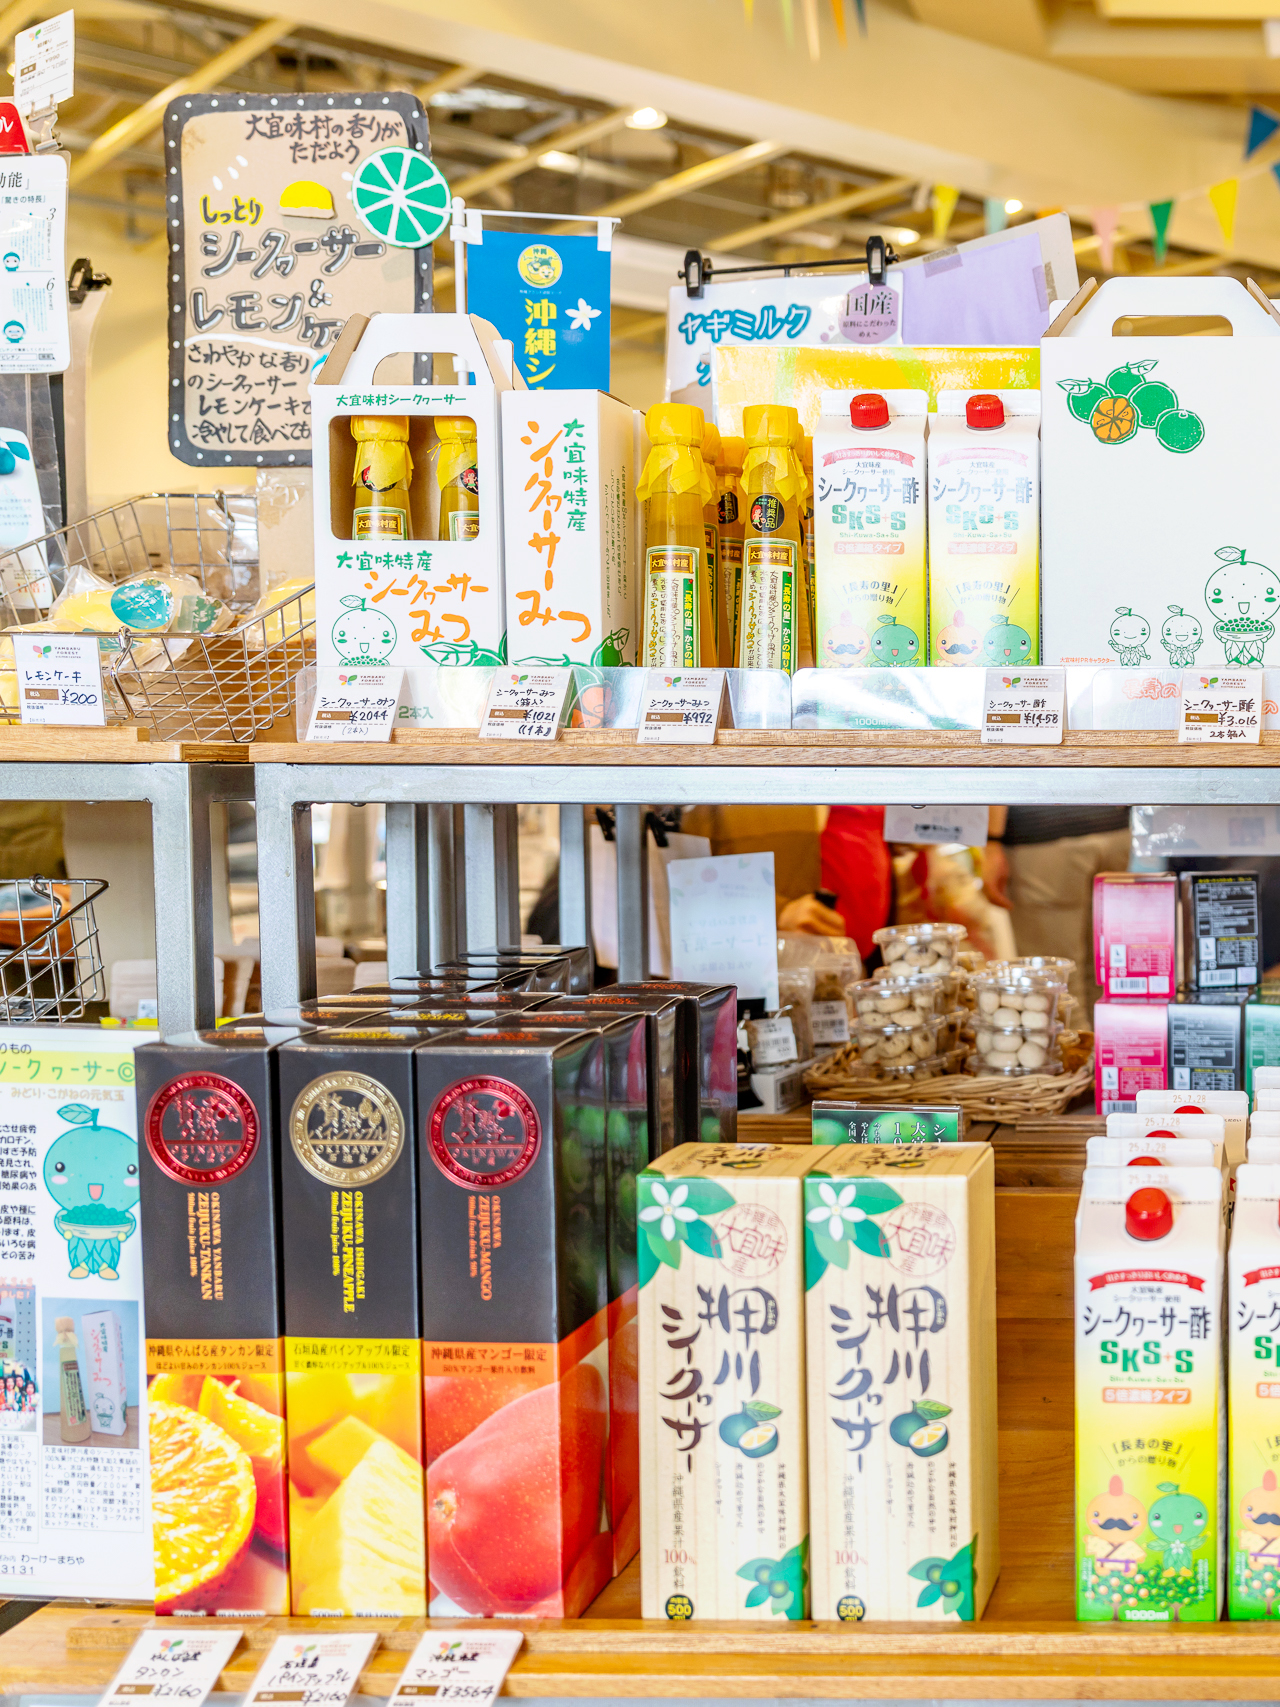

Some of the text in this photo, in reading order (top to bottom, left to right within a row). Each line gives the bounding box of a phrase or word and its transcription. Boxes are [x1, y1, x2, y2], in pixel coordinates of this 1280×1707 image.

[245, 113, 403, 143] 大宜味村の香りが
[290, 140, 361, 164] ただよう
[201, 195, 264, 226] しっとり
[189, 278, 334, 333] レモン &
[845, 291, 893, 318] 国産
[679, 303, 812, 345] ヤギミルク
[563, 417, 588, 532] 大宜味特産
[818, 476, 920, 505] シークヮーサー酢
[932, 476, 1033, 504] シークヮーサー酢
[336, 551, 433, 572] 大宜味特産
[408, 609, 472, 643] みつ
[515, 589, 592, 643] みつ
[25, 670, 82, 684] レモンケーキ
[61, 688, 98, 706] ¥200
[349, 710, 388, 723] ¥2044
[398, 705, 434, 720] 2本入
[683, 711, 713, 725] ¥992
[1172, 1094, 1207, 1104] 25.7.28
[1145, 1117, 1181, 1127] 25.7.28
[491, 1195, 502, 1250] OKINAWA
[211, 1191, 224, 1301] OKINAWA YANBARU
[354, 1190, 366, 1300] OKINAWA ISHIGAKI
[1083, 1304, 1212, 1340] シークヮーサー酢
[667, 1603, 692, 1616] 500
[838, 1604, 864, 1617] 500
[441, 1684, 495, 1699] ¥3564
